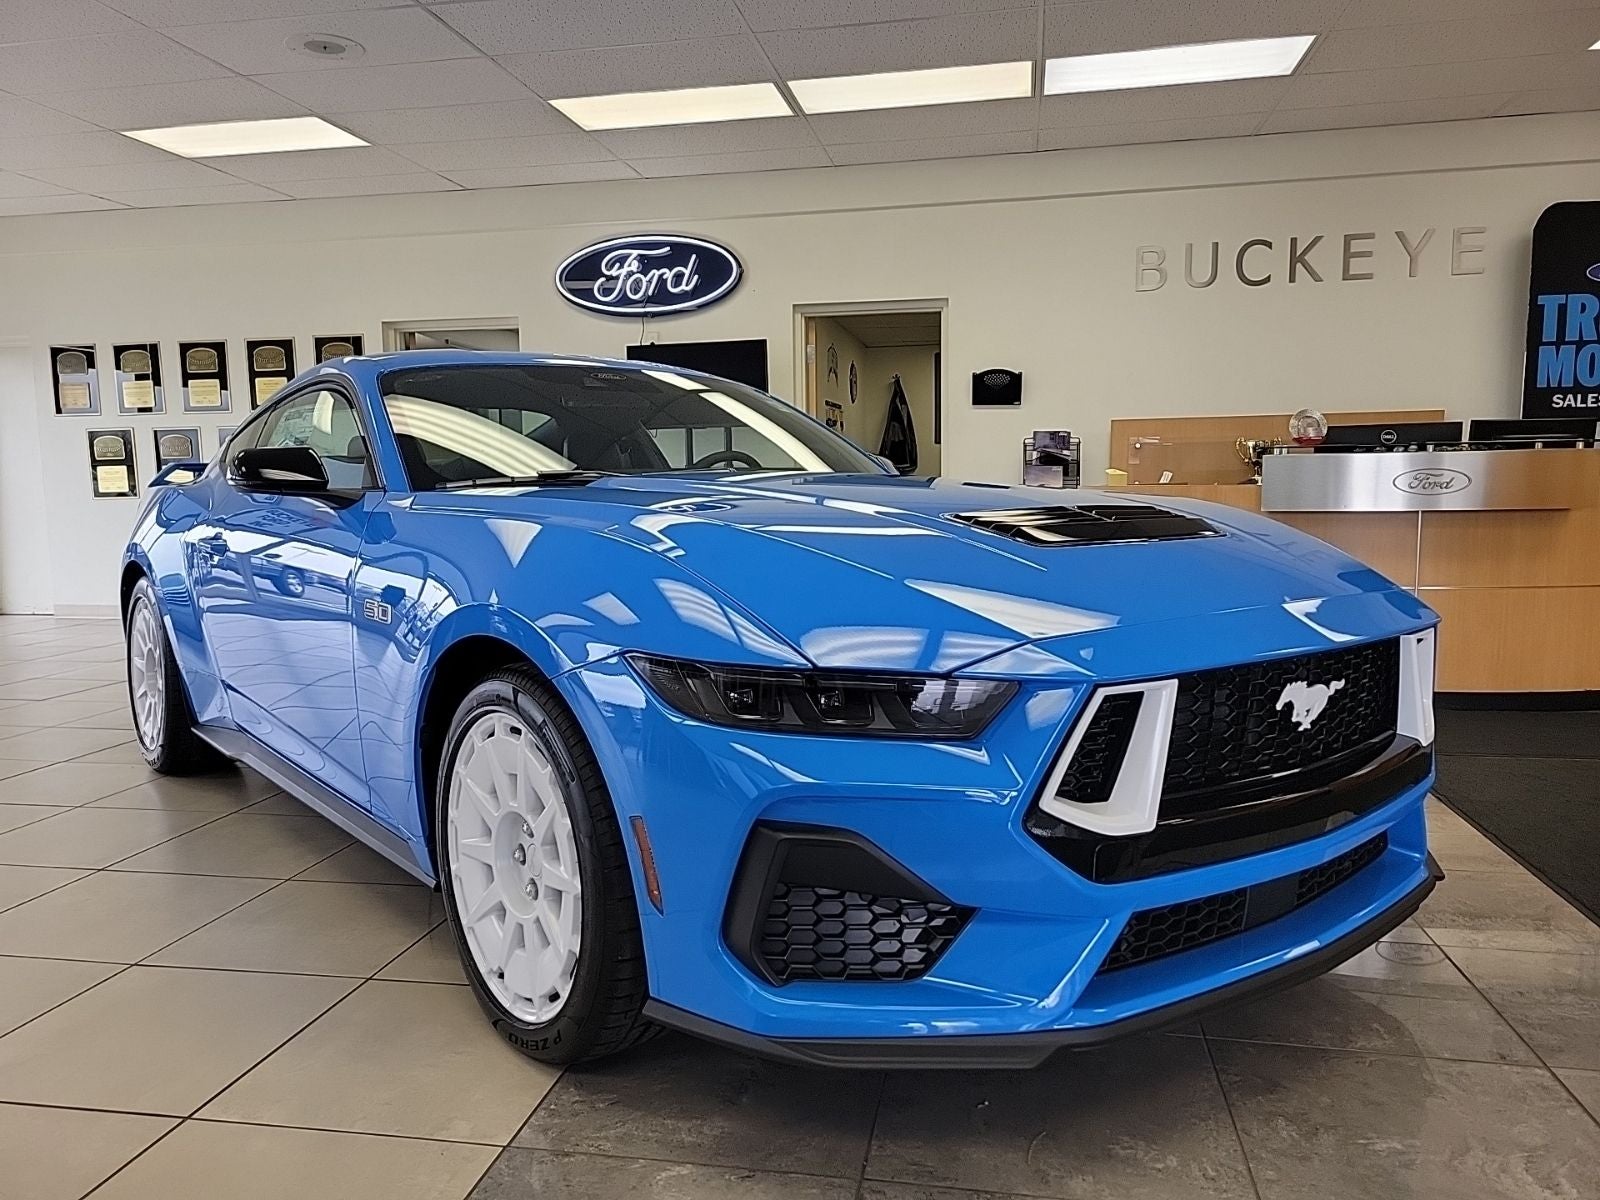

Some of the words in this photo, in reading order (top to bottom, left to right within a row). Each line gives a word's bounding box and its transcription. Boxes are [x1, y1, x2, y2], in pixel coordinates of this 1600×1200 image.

[593, 246, 698, 302] Ford
[1134, 226, 1487, 293] BUCKEYE
[1537, 293, 1600, 342] TR
[1536, 343, 1600, 388] MO
[1408, 472, 1455, 490] Ford
[508, 1032, 551, 1051] ZERO
[553, 1029, 562, 1046] P
